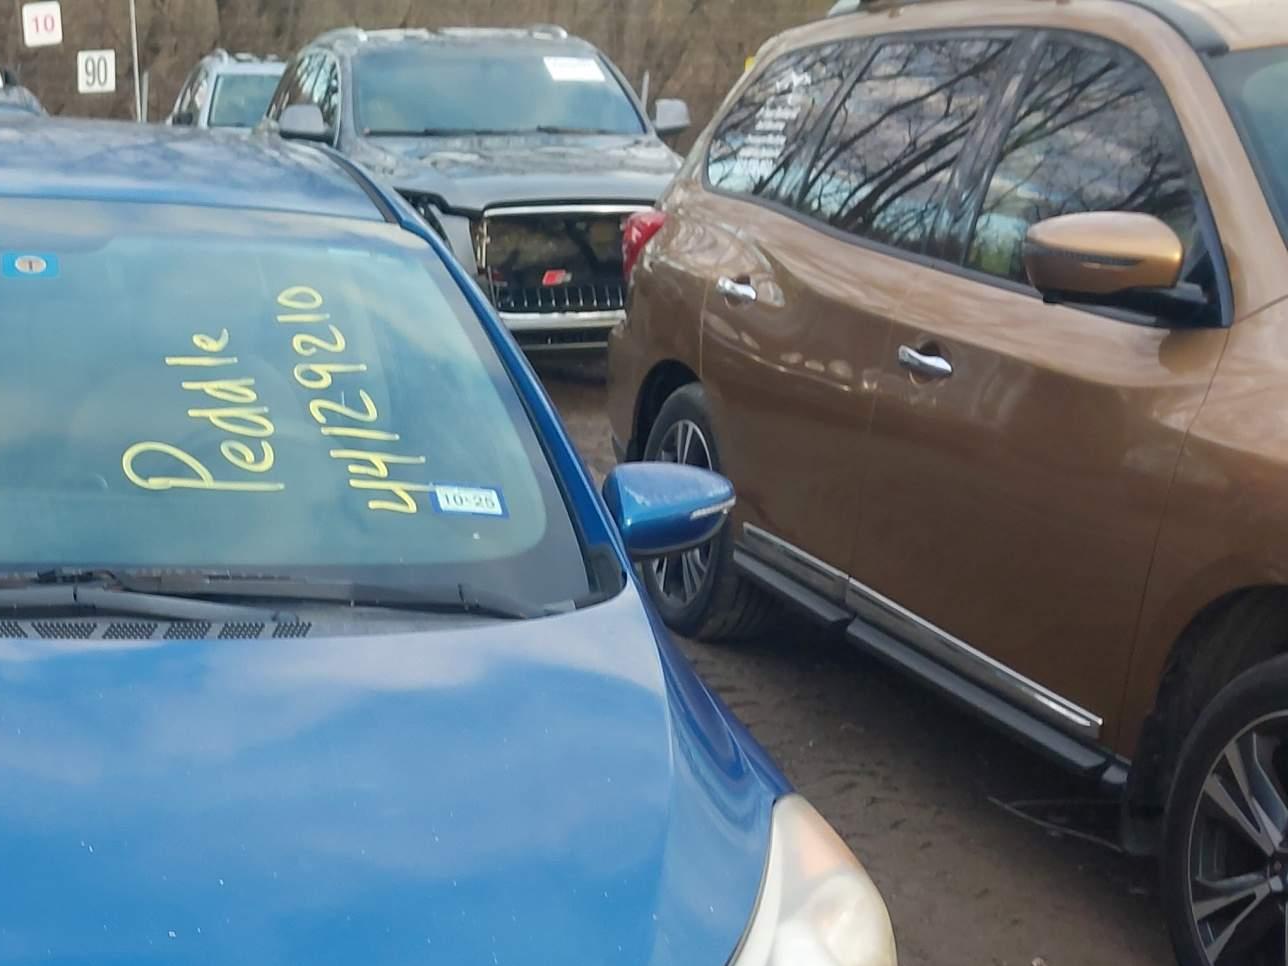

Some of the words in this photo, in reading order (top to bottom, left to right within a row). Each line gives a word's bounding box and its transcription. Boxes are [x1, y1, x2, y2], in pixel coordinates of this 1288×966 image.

[33, 14, 55, 33] 10
[84, 55, 108, 87] 90
[122, 328, 285, 490] Peddle
[277, 285, 434, 513] 44129210
